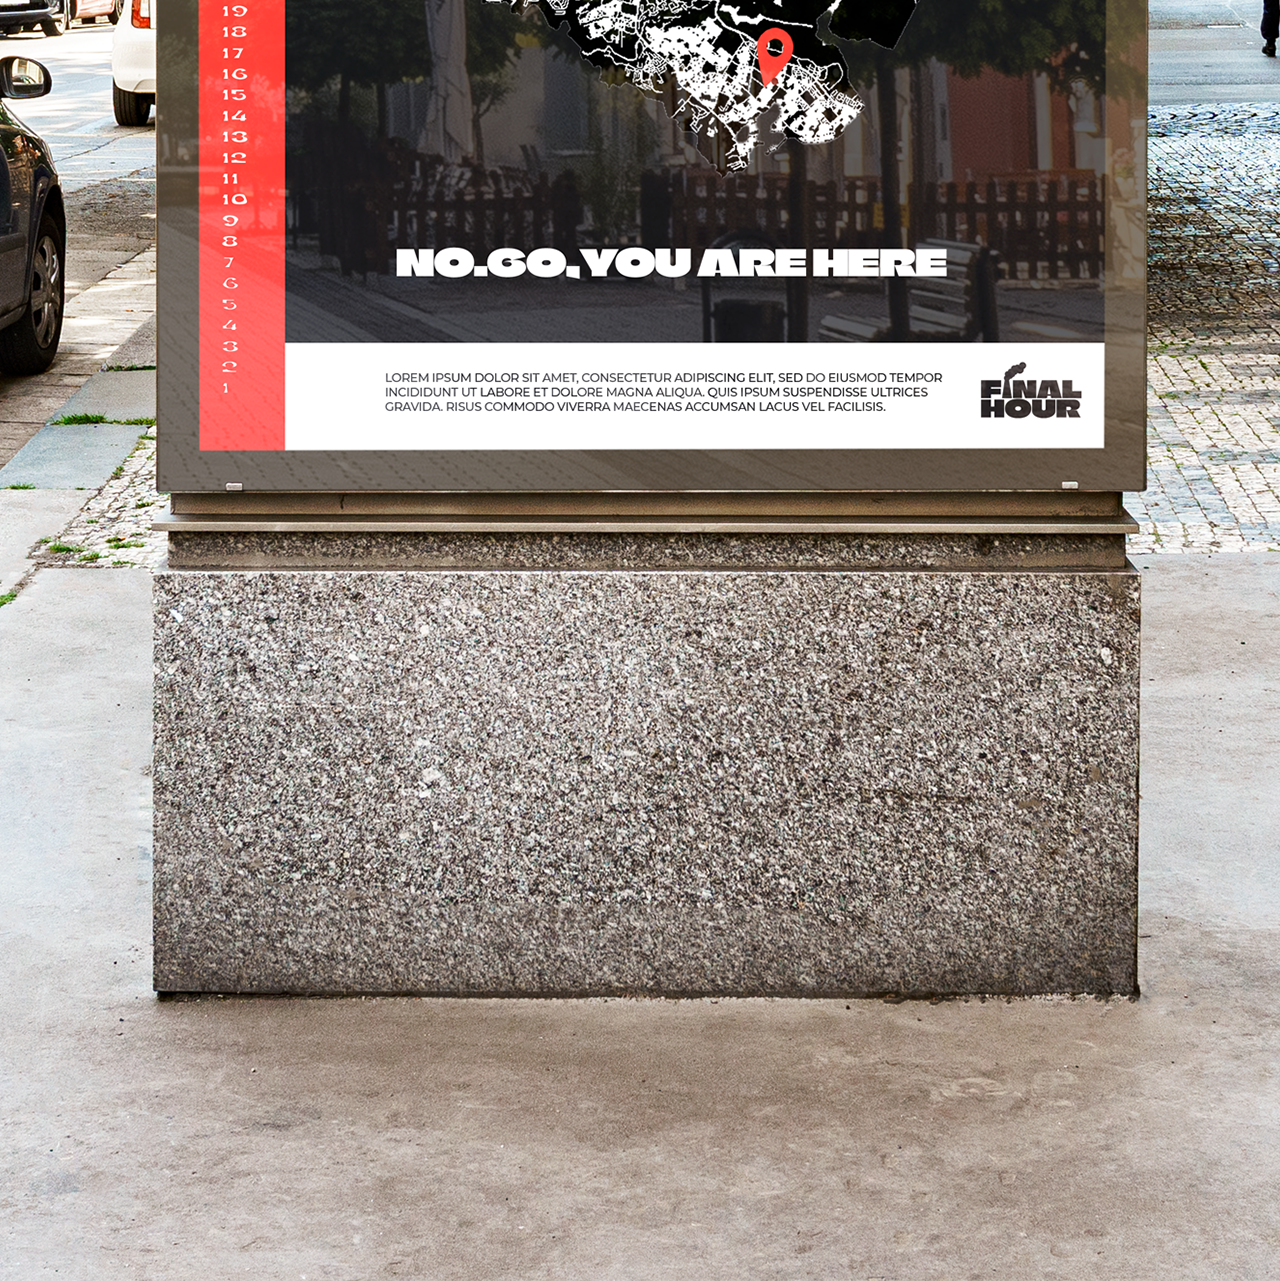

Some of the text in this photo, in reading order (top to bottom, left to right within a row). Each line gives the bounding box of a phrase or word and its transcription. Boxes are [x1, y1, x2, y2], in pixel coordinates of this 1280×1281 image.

[222, 5, 248, 18] 19
[222, 25, 247, 38] 18
[222, 47, 244, 59] 17
[222, 67, 248, 80] 16
[222, 89, 247, 101] 15
[222, 109, 247, 122] 14
[222, 130, 248, 143] 13
[222, 152, 247, 164] 12
[222, 173, 238, 185] 11
[222, 193, 248, 205] 10
[222, 214, 239, 227] 9
[221, 235, 238, 247] 8
[223, 256, 234, 268] 7
[579, 247, 692, 279] YOU
[697, 248, 807, 277] ARE
[813, 248, 947, 277] HERE
[222, 277, 239, 289] 6
[222, 299, 237, 310] 5
[222, 319, 237, 331] 4
[222, 340, 239, 352] 3
[222, 361, 238, 373] 2
[385, 372, 943, 385] LOREM IPSUM DOLOR SIT AMET, CONSECTETUR ADIPISCING ELIT, SED DO EIUSMOD TEMPOR
[223, 382, 229, 394] 1
[980, 374, 1082, 399] FINAL
[385, 386, 929, 400] INCIDIDUNT UT LABORE ET DOLORE MAGNA ALIQUA. QUIS IPSUM SUSPENDISSE ULTRICES
[384, 401, 886, 412] GRAVIDA. RISUS COMMODO VIVERRA MAECENAS ACCUMSAN LACUS VEL FACILISIS.
[980, 399, 1081, 419] HOUR
